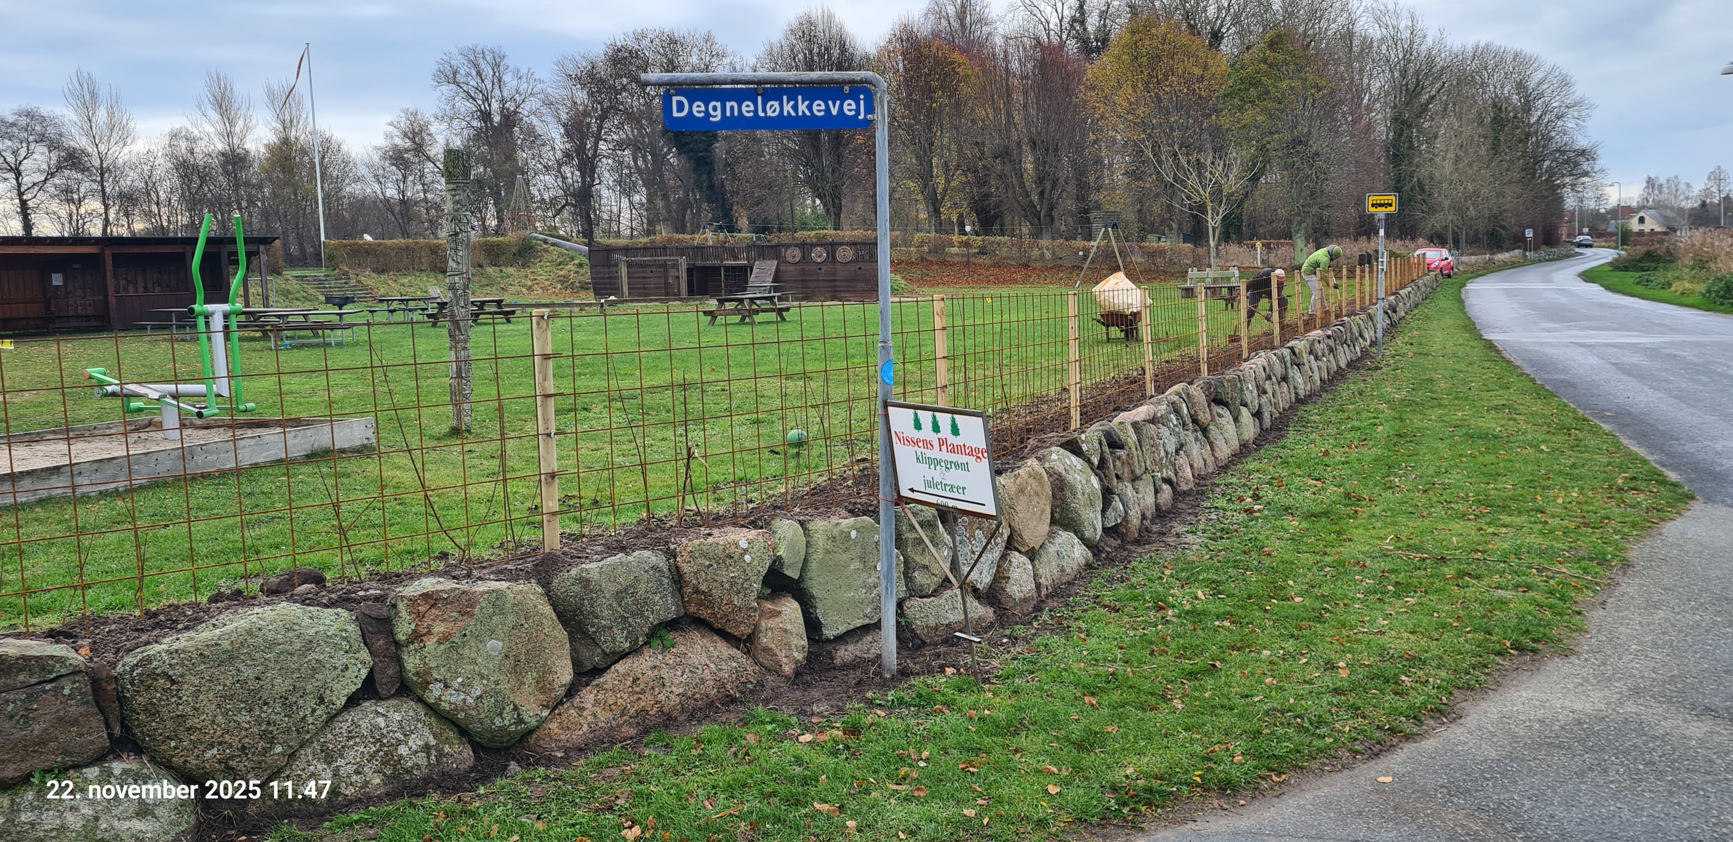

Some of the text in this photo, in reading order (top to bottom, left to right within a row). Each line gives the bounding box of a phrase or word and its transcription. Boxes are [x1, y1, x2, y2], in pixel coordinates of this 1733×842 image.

[671, 94, 866, 121] Degneløkkevej
[894, 430, 988, 463] Nissens Plantage
[915, 450, 970, 473] klippegrønt
[923, 475, 967, 496] juletræer
